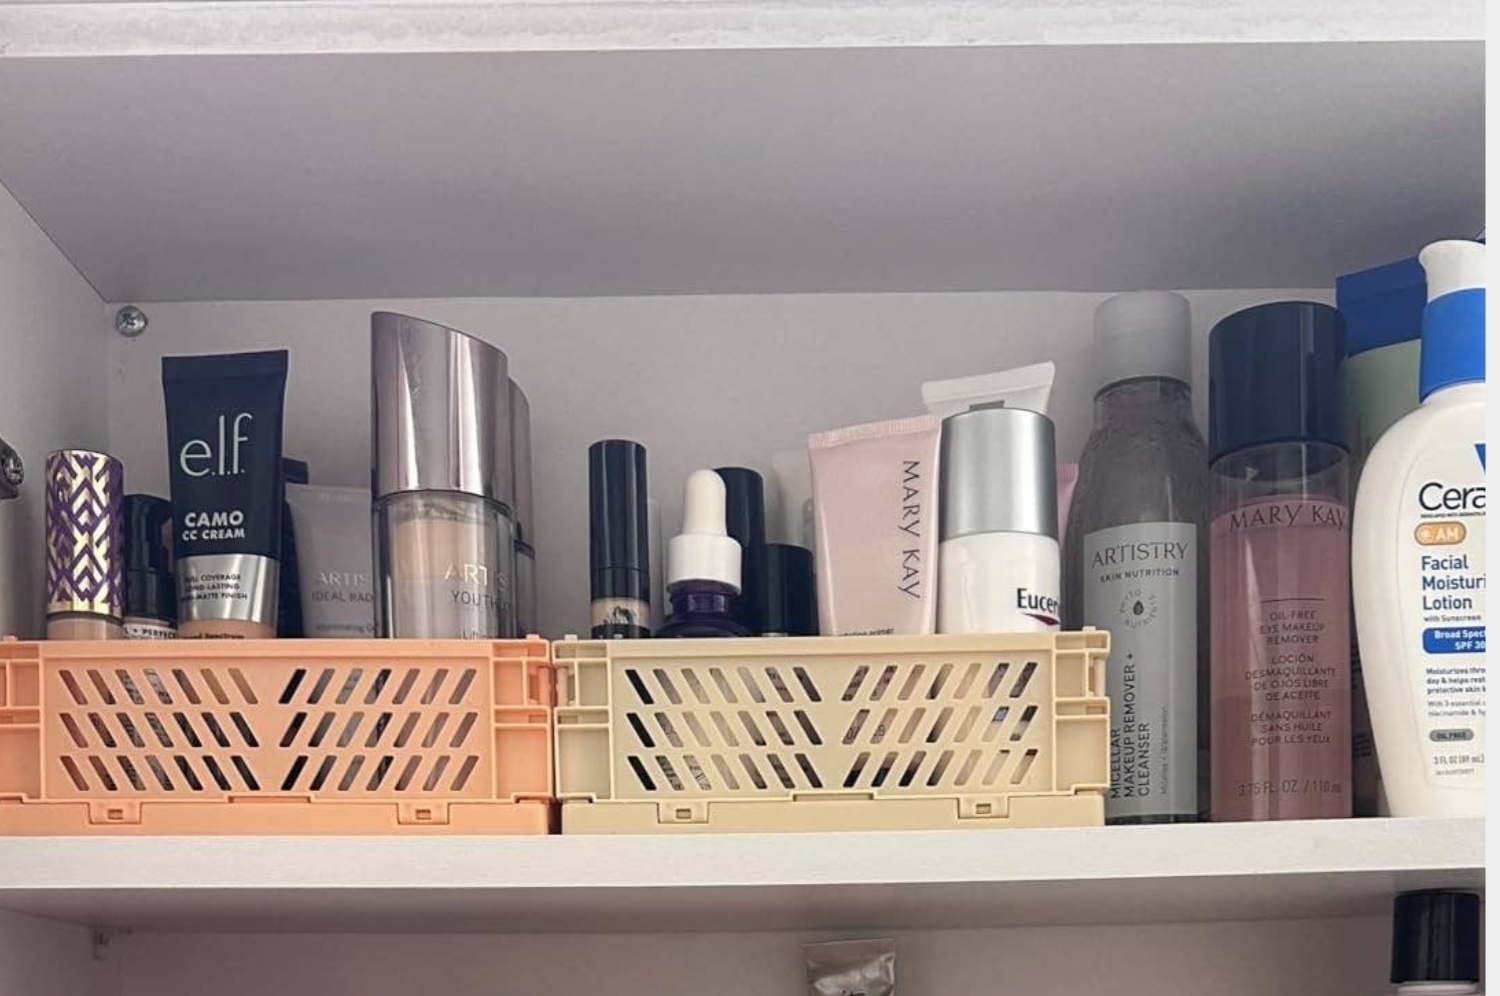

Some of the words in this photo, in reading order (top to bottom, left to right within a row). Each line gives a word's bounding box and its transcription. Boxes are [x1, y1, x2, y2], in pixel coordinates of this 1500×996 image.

[180, 412, 253, 477] e.l.f.
[898, 461, 920, 537] MARY
[184, 510, 244, 527] CAMO
[1229, 505, 1302, 533] MARY
[1312, 505, 1346, 531] KAY
[182, 530, 198, 541] CC
[201, 528, 245, 540] CREAM
[1436, 526, 1459, 540] AM
[1091, 541, 1189, 569] ARTISTRY
[1421, 554, 1469, 571] Facial
[201, 573, 242, 582] COVERAGE
[898, 549, 920, 599] KAY
[1125, 567, 1179, 578] NUTRITION
[207, 583, 240, 591] LASTING
[1017, 588, 1060, 615] Eucer
[1422, 594, 1473, 610] Lotion
[1269, 610, 1317, 621] OIL-FREE
[1260, 624, 1279, 635] EYE
[1282, 622, 1325, 632] MAKEUP
[1434, 630, 1461, 639] Broad
[1266, 635, 1319, 645] REMOVER
[1454, 640, 1473, 650] SPF
[1254, 681, 1267, 691] DE
[1271, 679, 1300, 689] OJOS
[1304, 679, 1330, 688] LIBRE
[1124, 663, 1135, 732] REMOVER
[1265, 692, 1280, 701] DE
[1282, 691, 1321, 700] ACEITE
[1261, 724, 1291, 733] SANS
[1293, 723, 1323, 731] HUILE
[1251, 735, 1281, 746] POUR
[1284, 735, 1303, 744] LES
[1307, 734, 1332, 744] YEUX
[1110, 727, 1121, 799] MICELLAR
[1138, 722, 1150, 797] CLEANSER
[1124, 737, 1135, 797] MAKEUP
[1282, 780, 1299, 792] OZ
